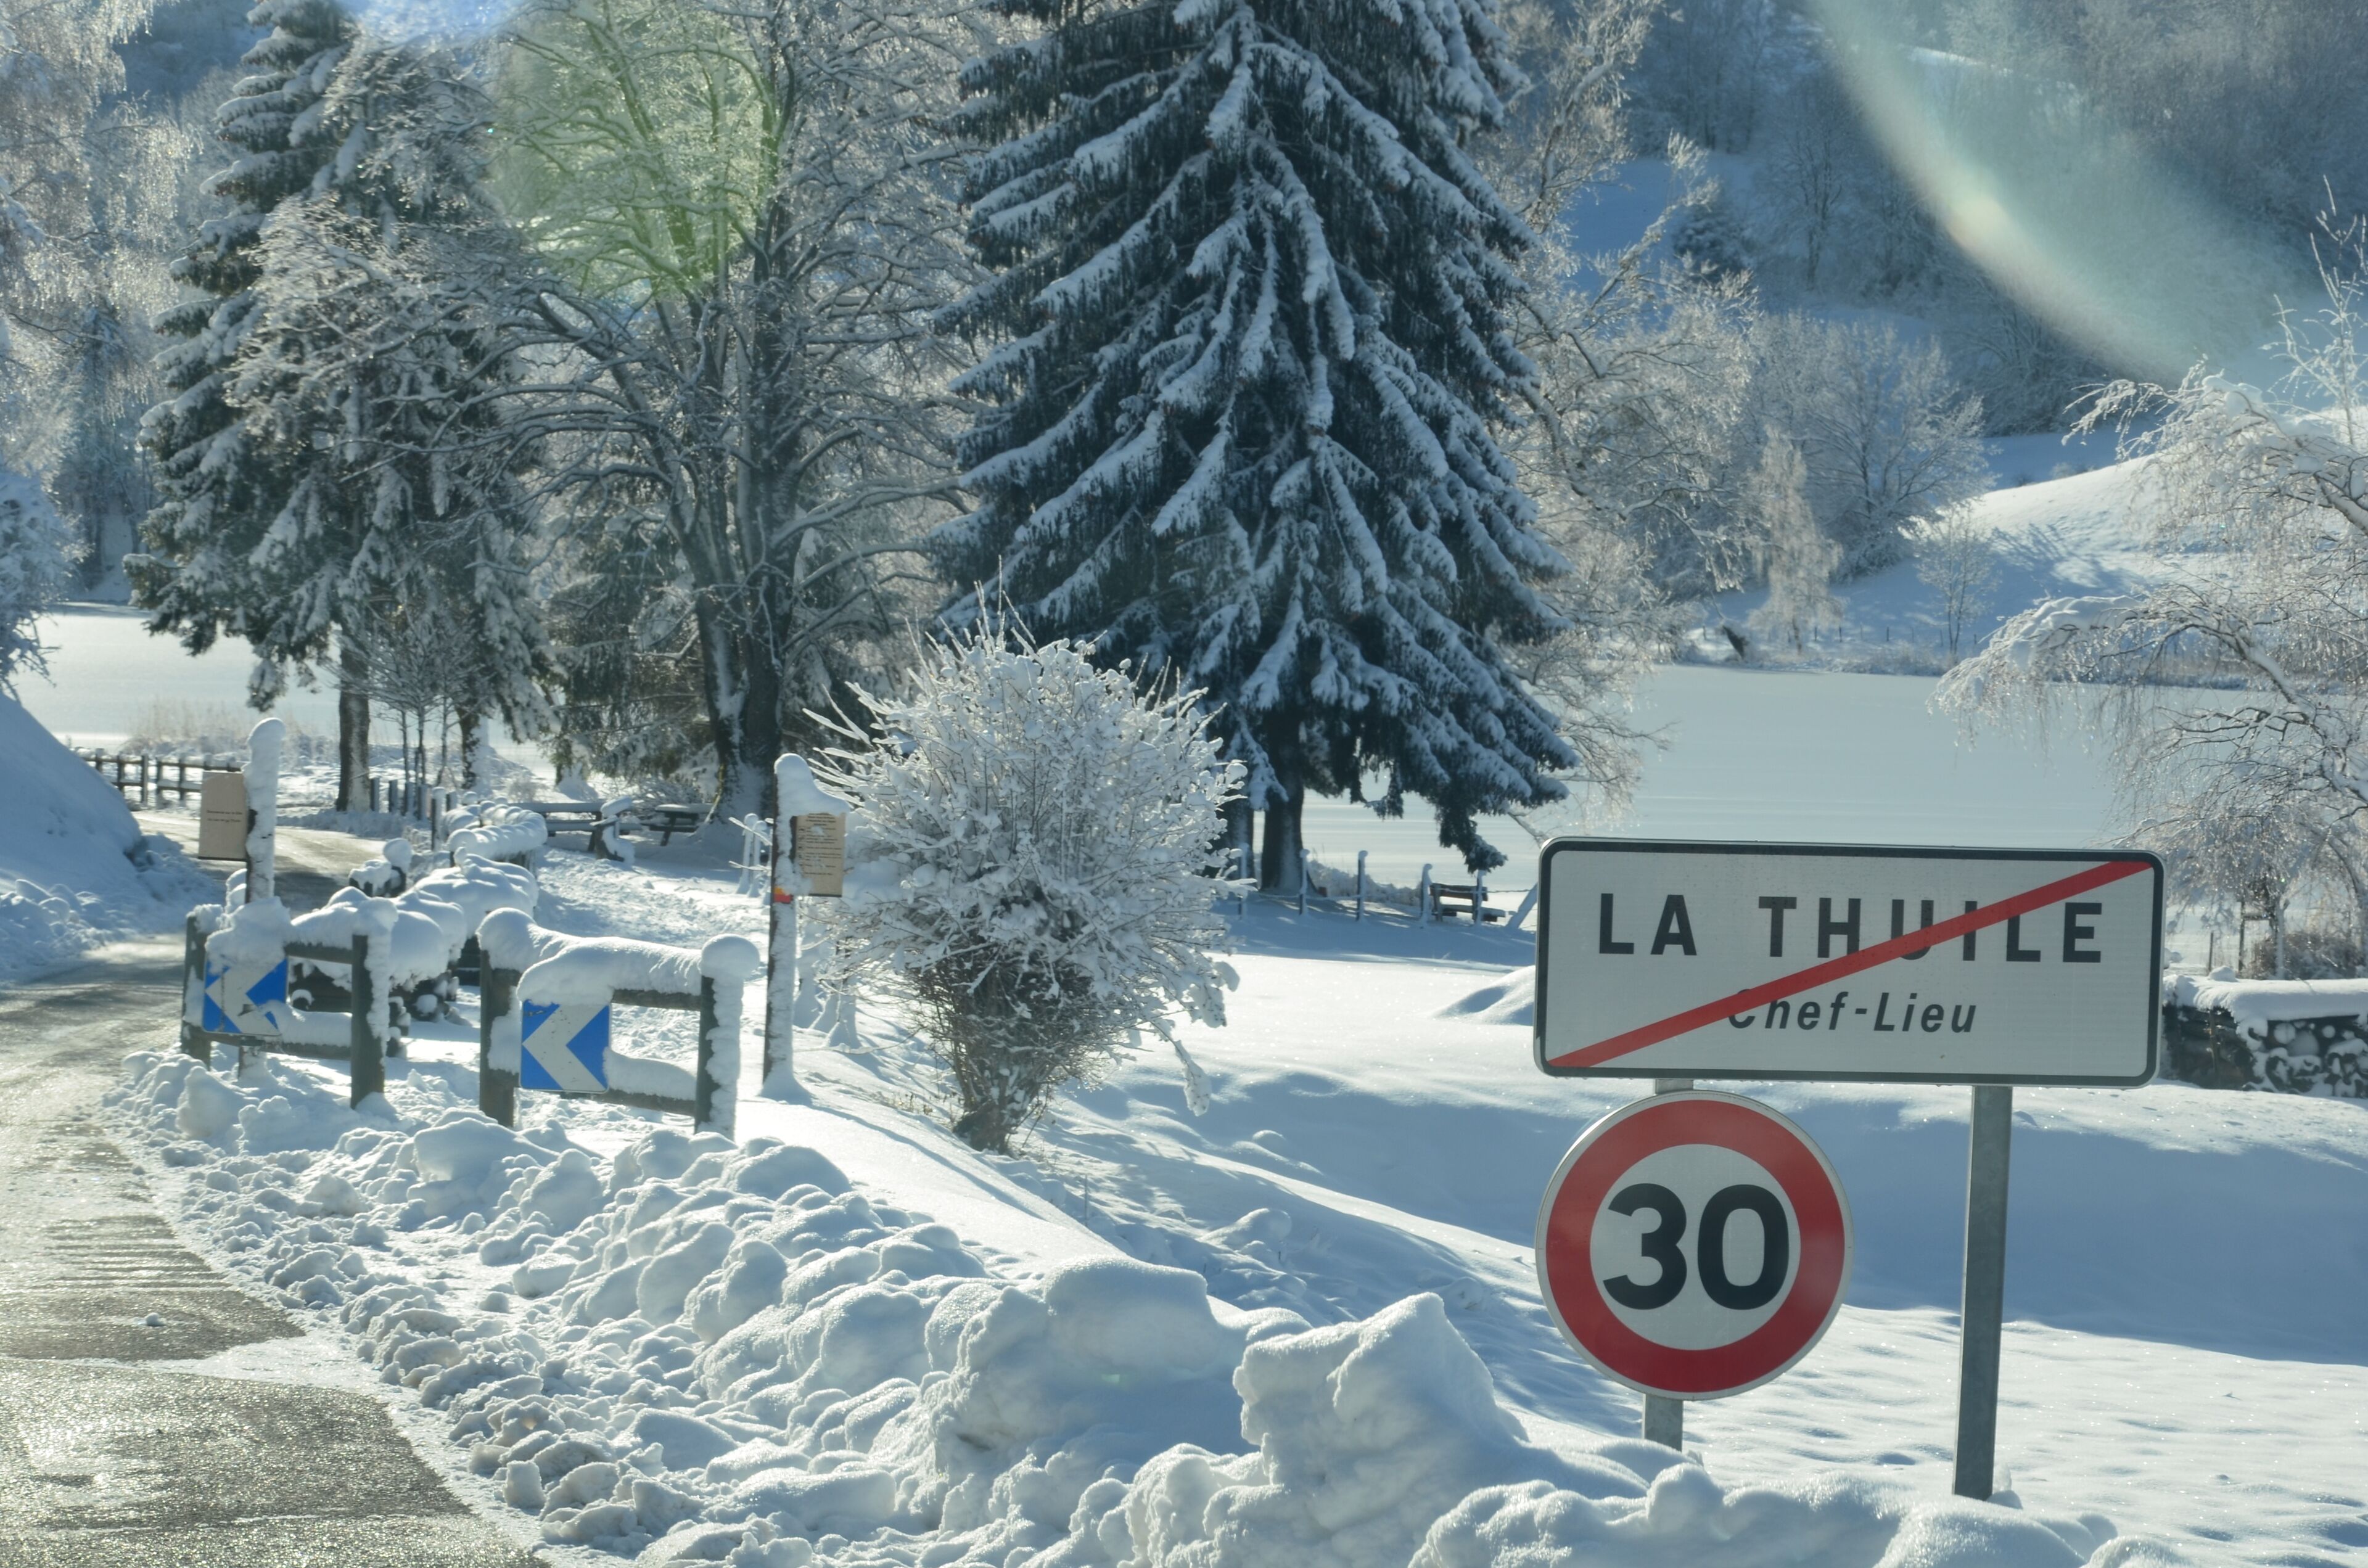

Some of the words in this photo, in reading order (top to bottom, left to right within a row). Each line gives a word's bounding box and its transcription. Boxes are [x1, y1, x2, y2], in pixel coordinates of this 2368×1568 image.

[1600, 892, 1697, 956] LA
[1758, 896, 2102, 963] THUILE
[1603, 1183, 1790, 1310] 30
